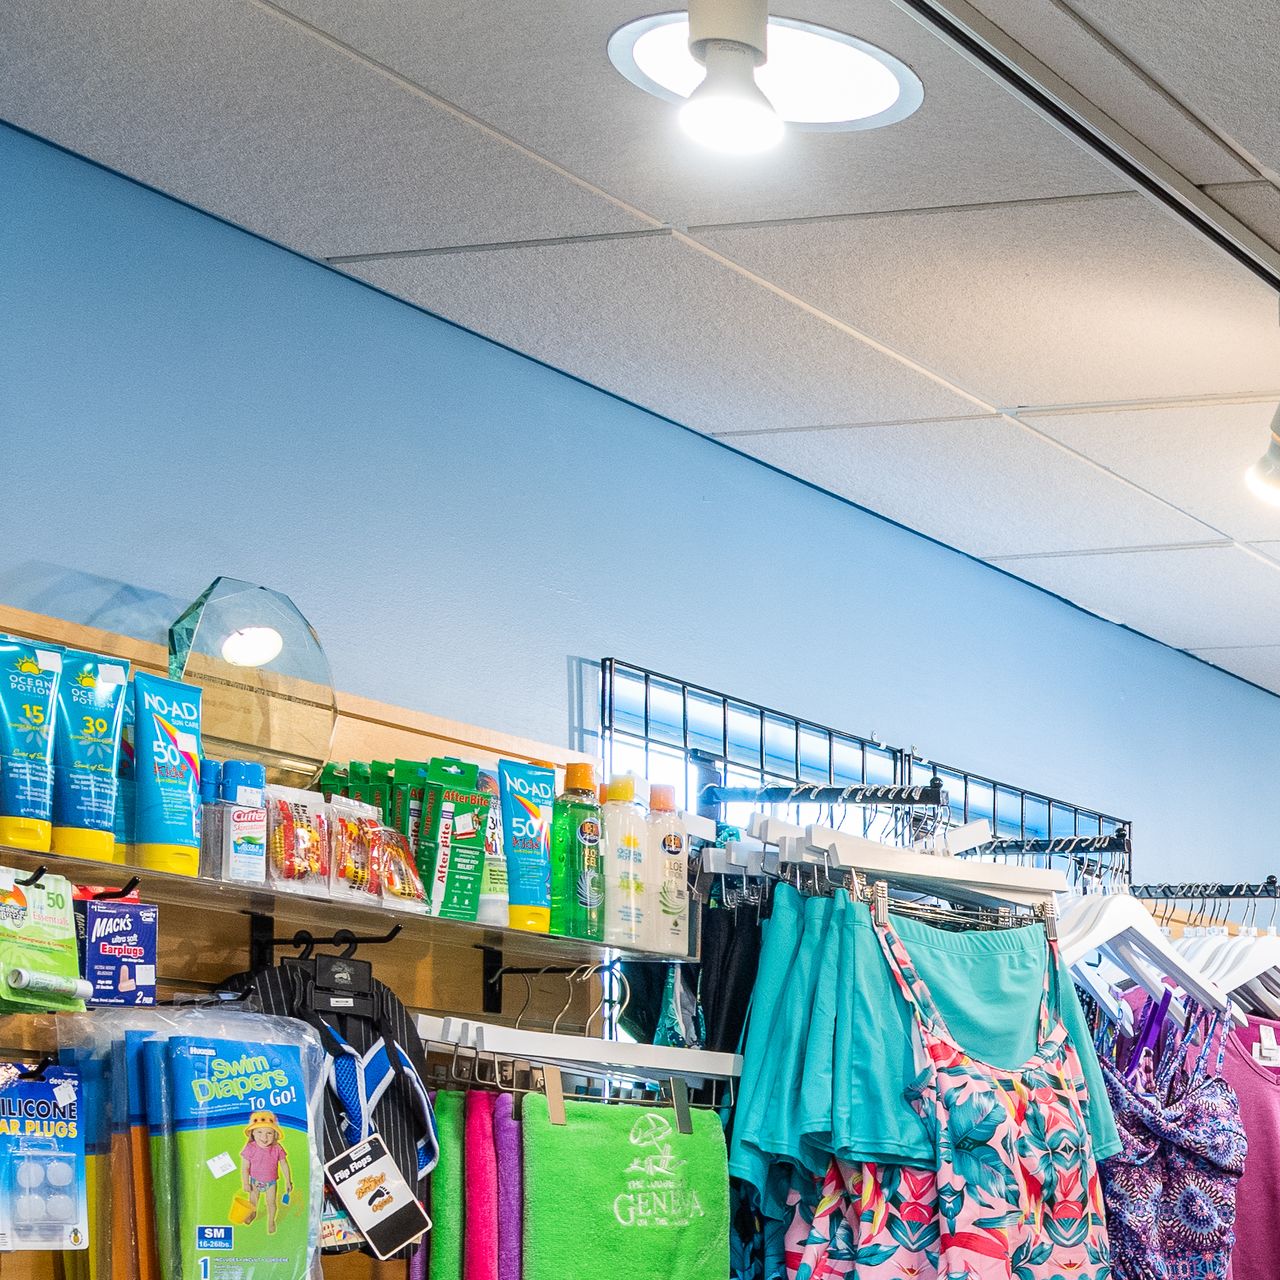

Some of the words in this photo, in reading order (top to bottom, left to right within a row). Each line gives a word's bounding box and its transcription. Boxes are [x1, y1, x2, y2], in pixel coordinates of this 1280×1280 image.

[9, 675, 53, 689] OCEAN
[22, 704, 44, 724] 15
[143, 692, 197, 720] NO-AD
[82, 716, 107, 734] 30
[153, 741, 180, 765] 50
[506, 770, 551, 797] NO-AD
[443, 790, 468, 803] After
[470, 793, 488, 806] Bite
[231, 809, 265, 823] Cutter
[439, 823, 450, 850] Bite
[512, 818, 533, 837] 50
[437, 851, 449, 883] After
[47, 892, 64, 910] 50
[91, 914, 133, 943] MACK'S
[101, 943, 144, 957] Earplugs
[135, 991, 143, 1003] 2
[211, 1054, 269, 1079] Swim
[191, 1068, 289, 1102] Diapers
[248, 1095, 266, 1111] To
[269, 1087, 297, 1105] Go!
[27, 1122, 77, 1138] PLUGS
[333, 1166, 351, 1184] Flip
[348, 1153, 373, 1174] Flops
[204, 1227, 225, 1239] SM
